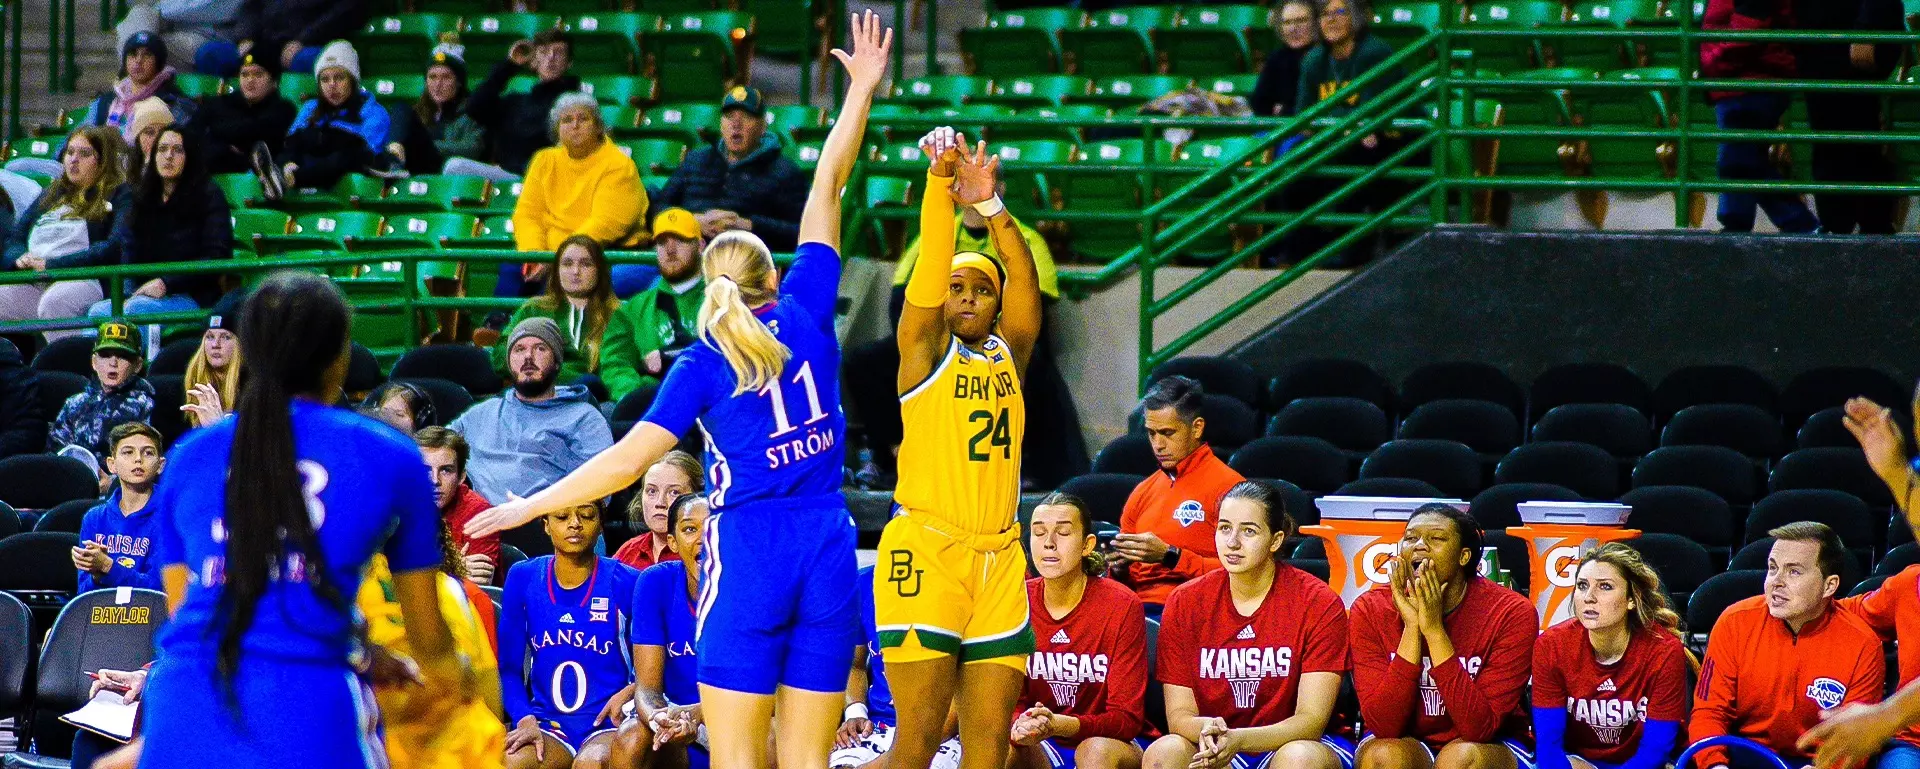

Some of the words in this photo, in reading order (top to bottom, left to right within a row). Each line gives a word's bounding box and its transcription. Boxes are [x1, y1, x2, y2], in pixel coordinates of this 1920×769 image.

[758, 360, 829, 439] 11
[954, 371, 1016, 401] BAYOR
[765, 427, 834, 469] STRÖM
[968, 407, 1011, 462] 24
[1174, 510, 1204, 520] KANSAS
[1544, 545, 1581, 588] G
[91, 606, 150, 624] BAYLOR
[530, 628, 613, 656] KANSAS
[1199, 646, 1292, 679] KANSAS
[551, 660, 588, 714] 0
[1808, 686, 1842, 702] KANSA
